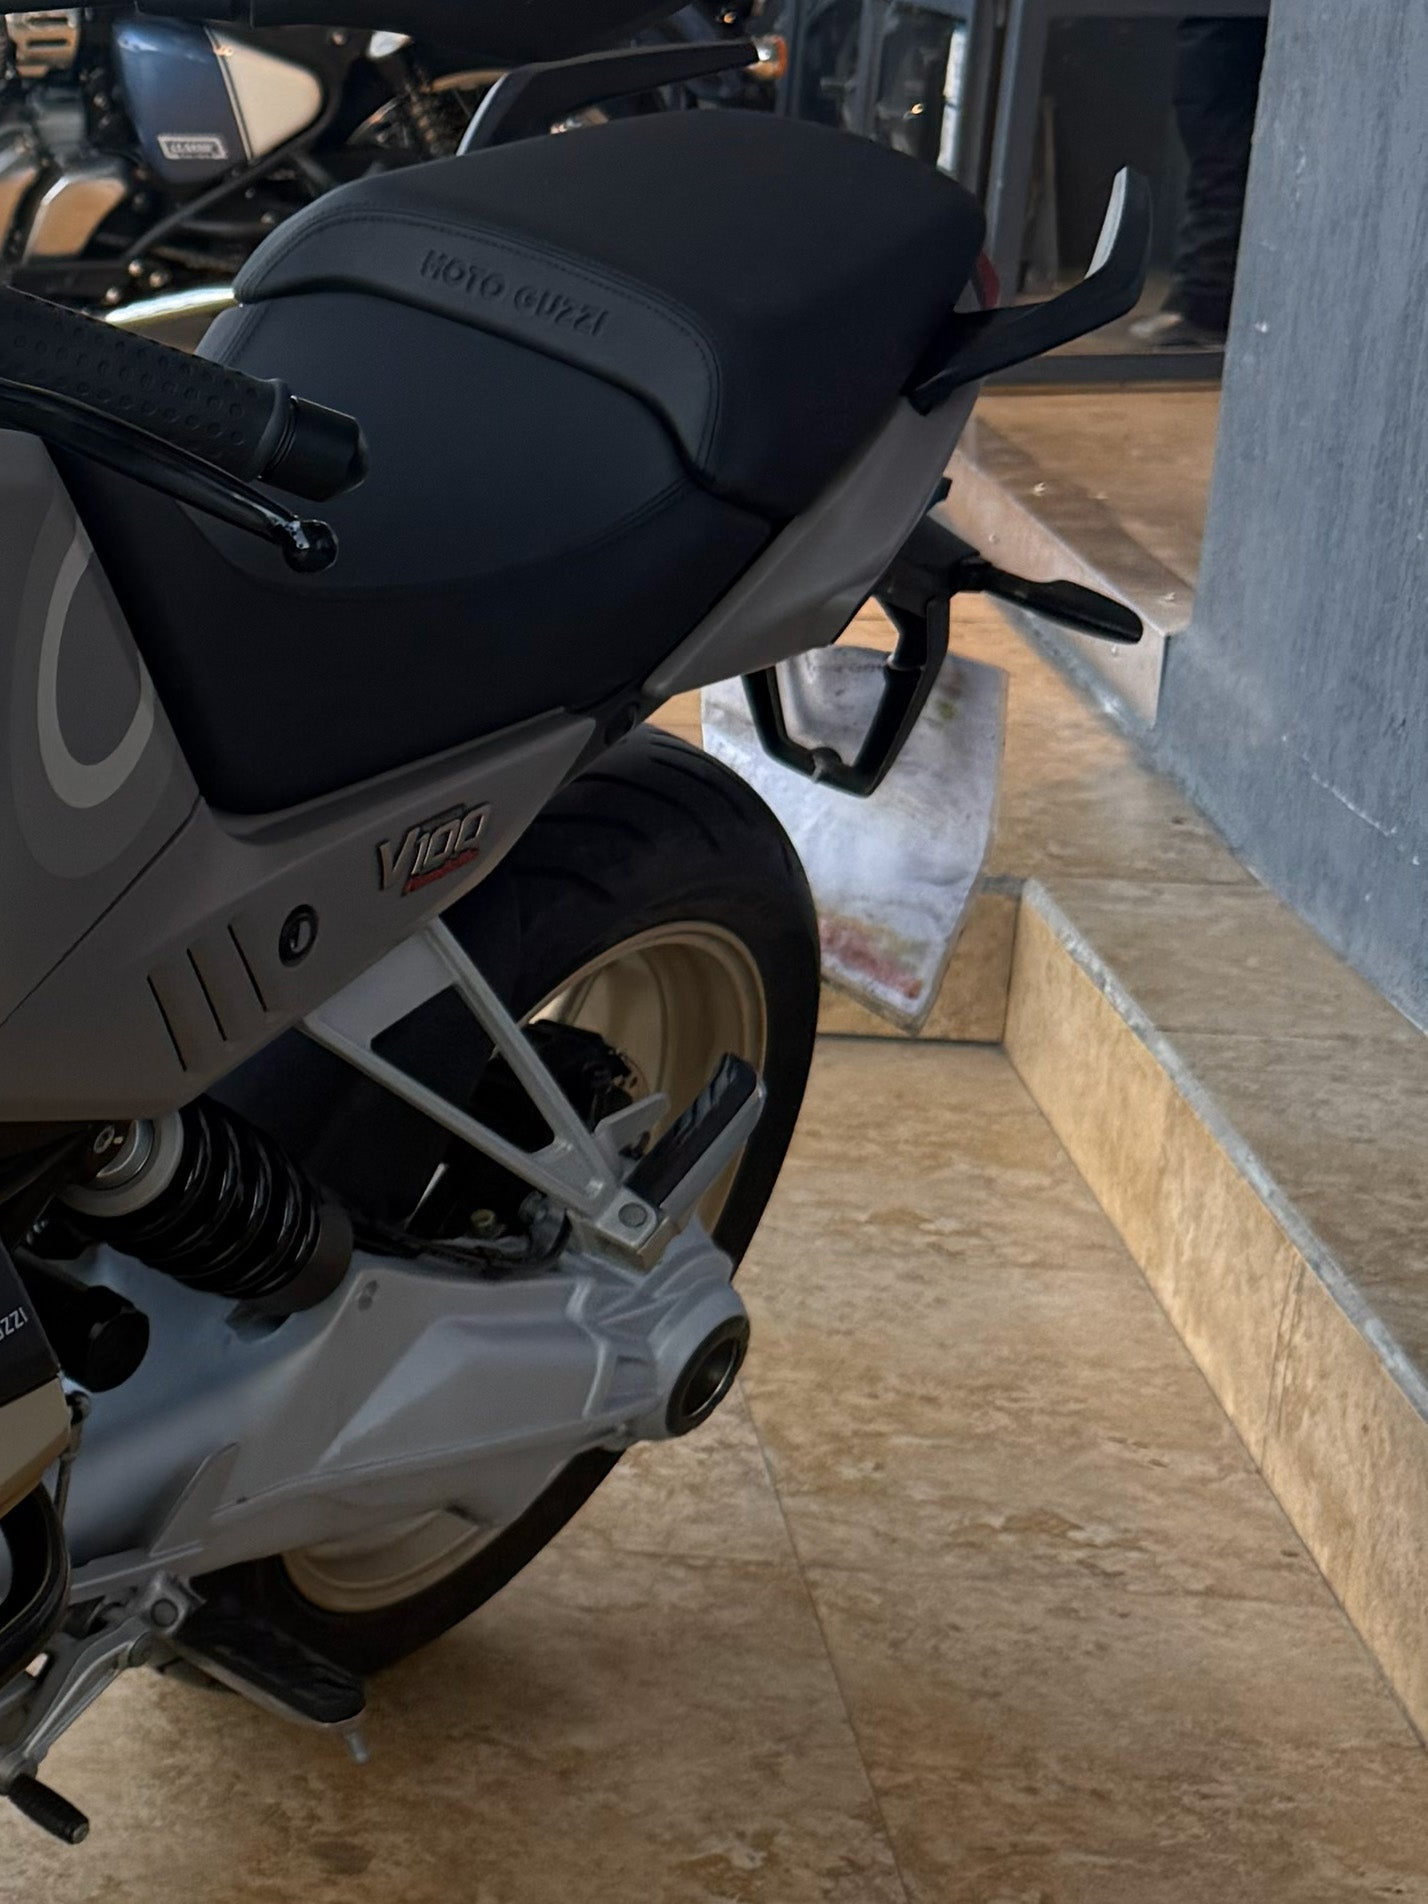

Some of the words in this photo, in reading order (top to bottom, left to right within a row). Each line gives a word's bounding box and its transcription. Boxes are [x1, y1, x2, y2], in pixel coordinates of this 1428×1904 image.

[419, 248, 505, 297] MOTO
[513, 285, 610, 336] GUZZI
[377, 802, 491, 890] V100
